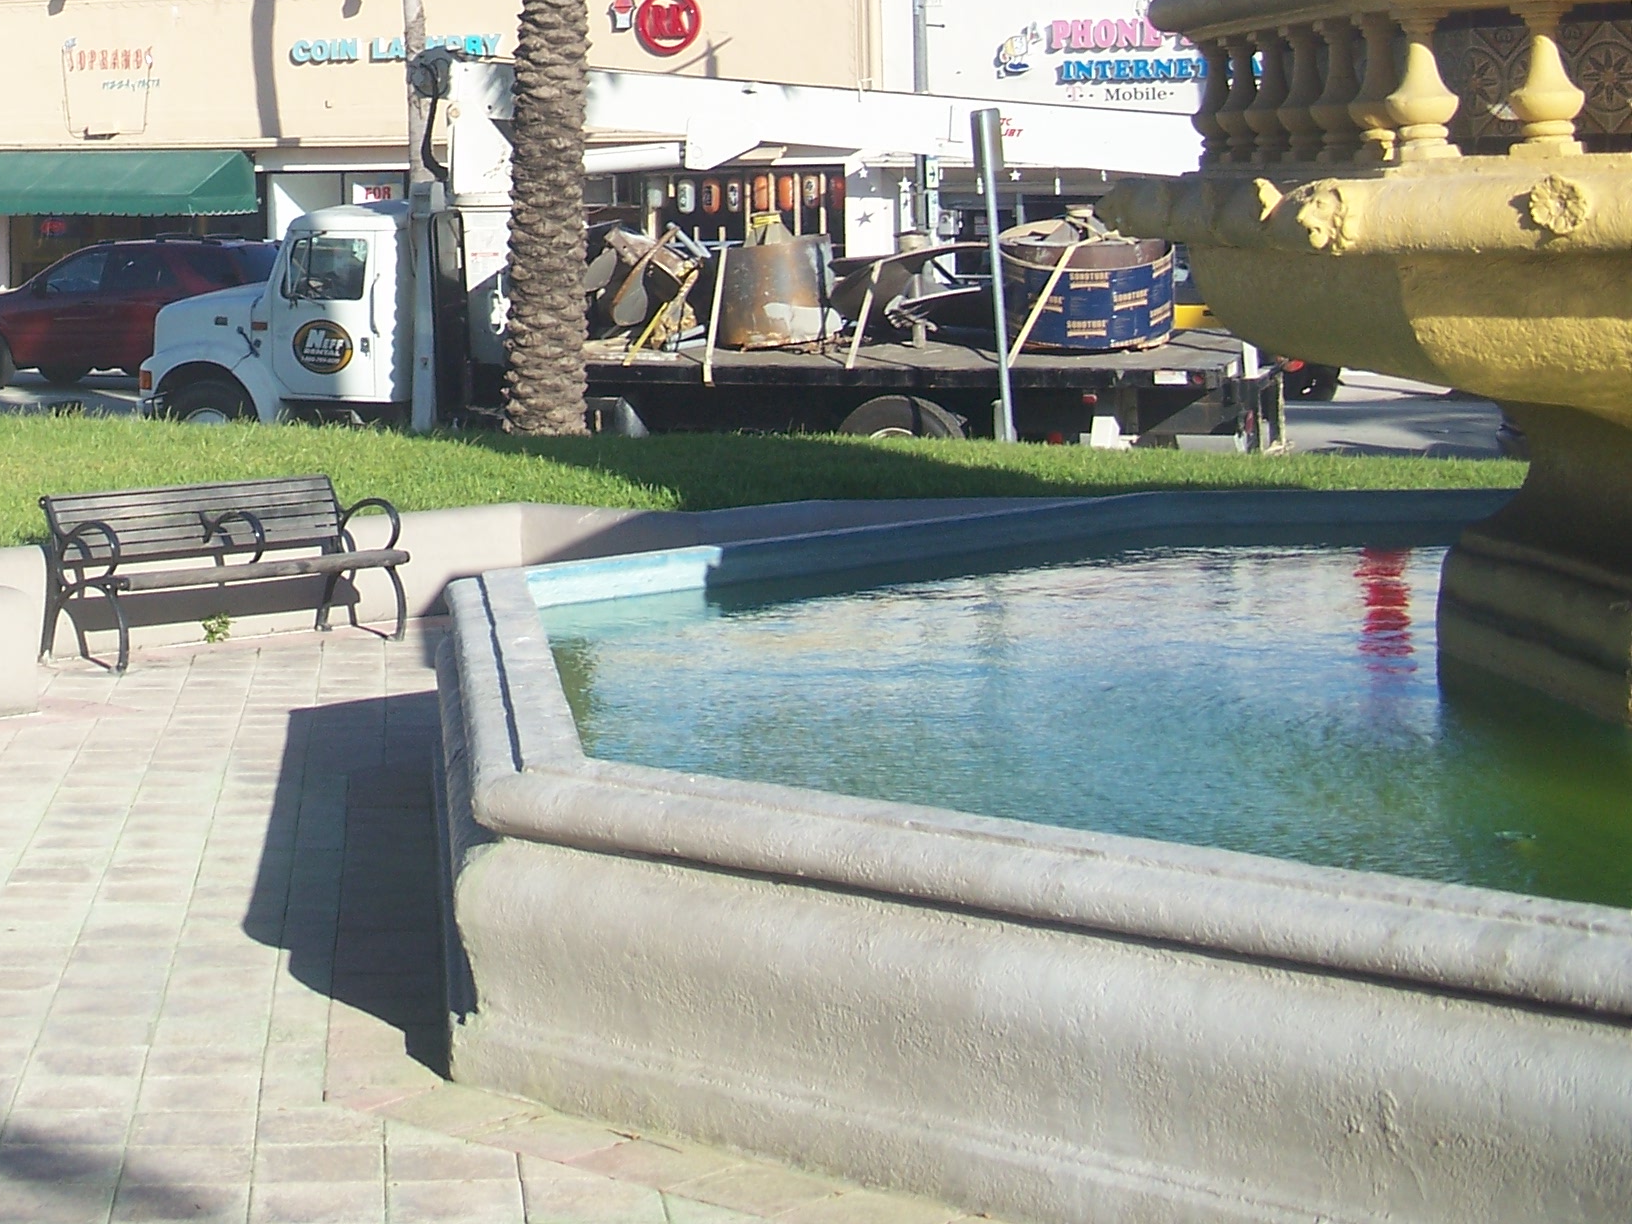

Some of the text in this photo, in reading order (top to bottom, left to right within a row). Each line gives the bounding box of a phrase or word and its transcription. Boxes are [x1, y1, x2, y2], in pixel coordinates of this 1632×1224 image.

[291, 37, 358, 63] COIN
[1103, 86, 1168, 102] Mobile
[364, 186, 391, 200] FOR
